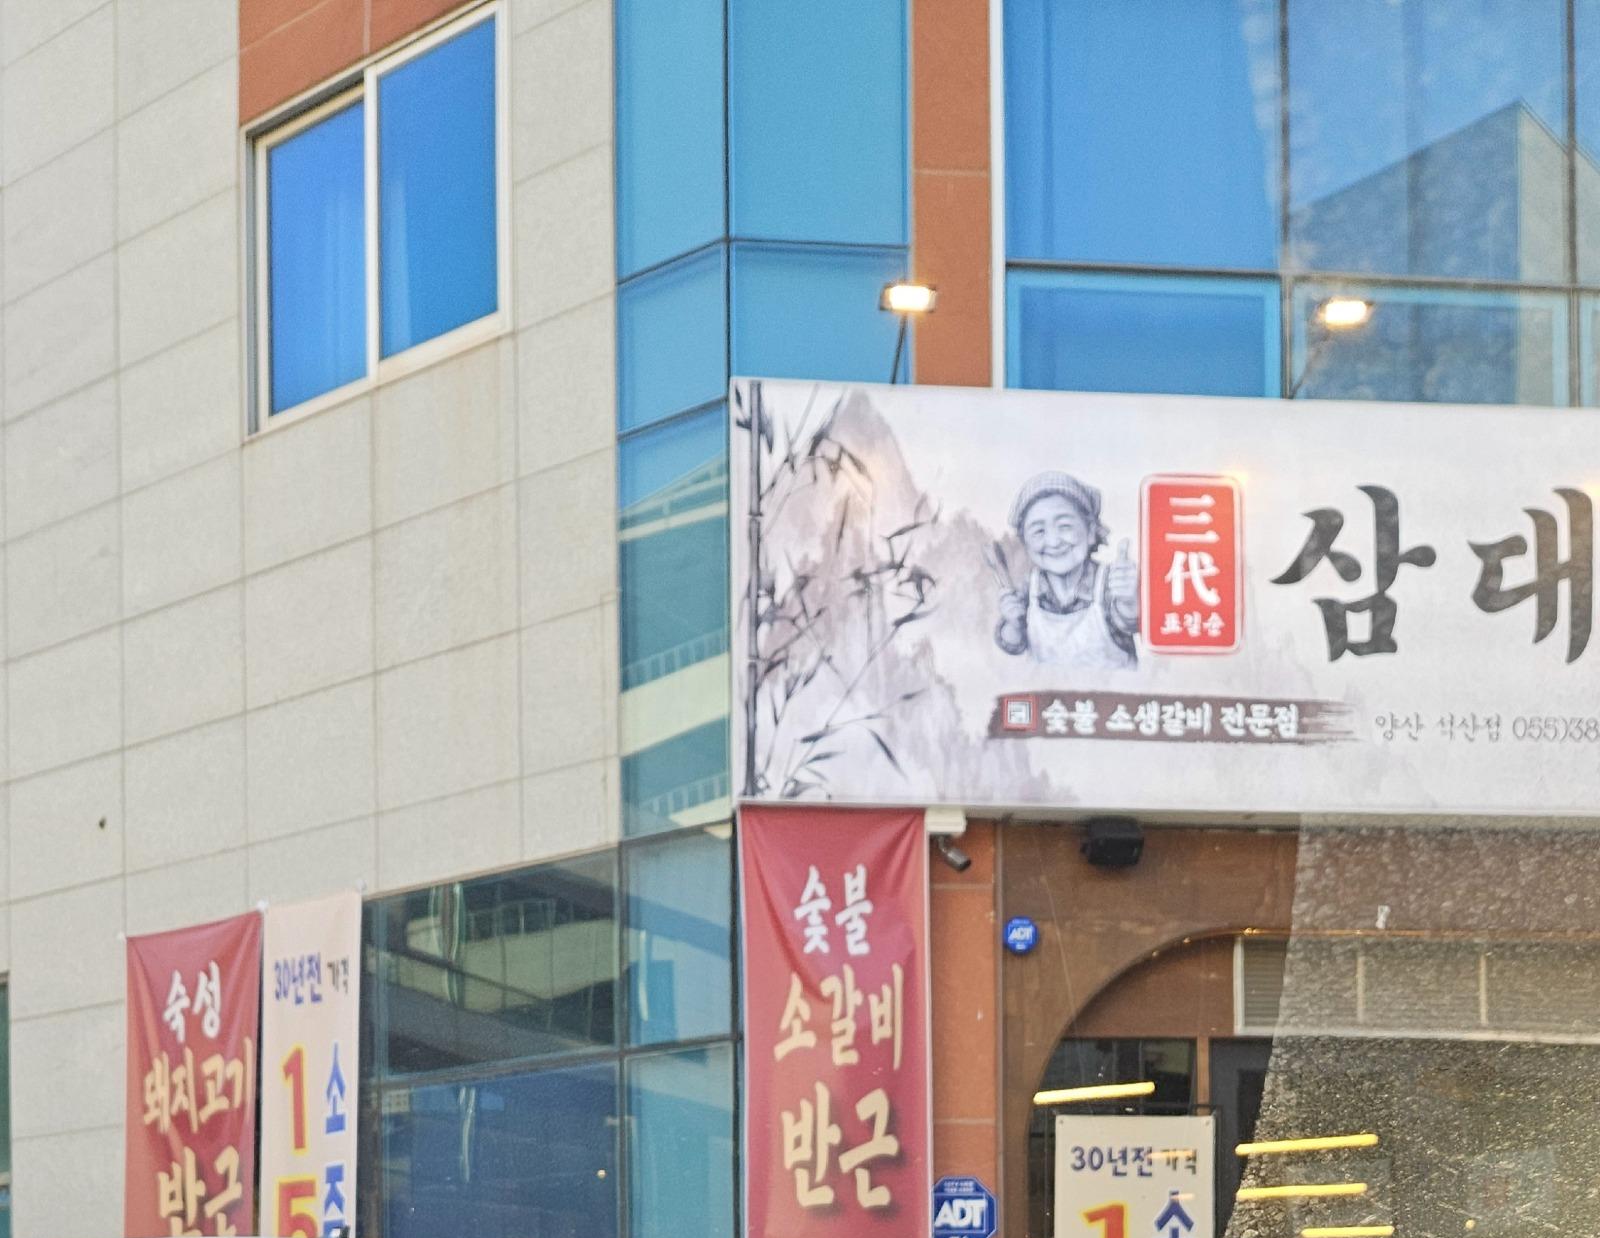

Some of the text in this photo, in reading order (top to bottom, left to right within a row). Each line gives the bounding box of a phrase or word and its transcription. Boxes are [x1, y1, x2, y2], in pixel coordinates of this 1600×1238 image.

[1164, 493, 1222, 606] 三代
[1270, 484, 1593, 665] 삼대
[1041, 699, 1300, 739] 숯불 소생갈비 전문점
[1375, 711, 1424, 742] 양산
[794, 863, 873, 957] 숯불
[163, 960, 222, 1043] 숙성
[274, 952, 322, 1005] 30년전
[773, 962, 904, 1071] 소갈비
[143, 1036, 254, 1135] 돼지고기
[781, 1081, 900, 1209] 반근
[1070, 1146, 1153, 1177] 30년전
[935, 1198, 987, 1229] ADT
